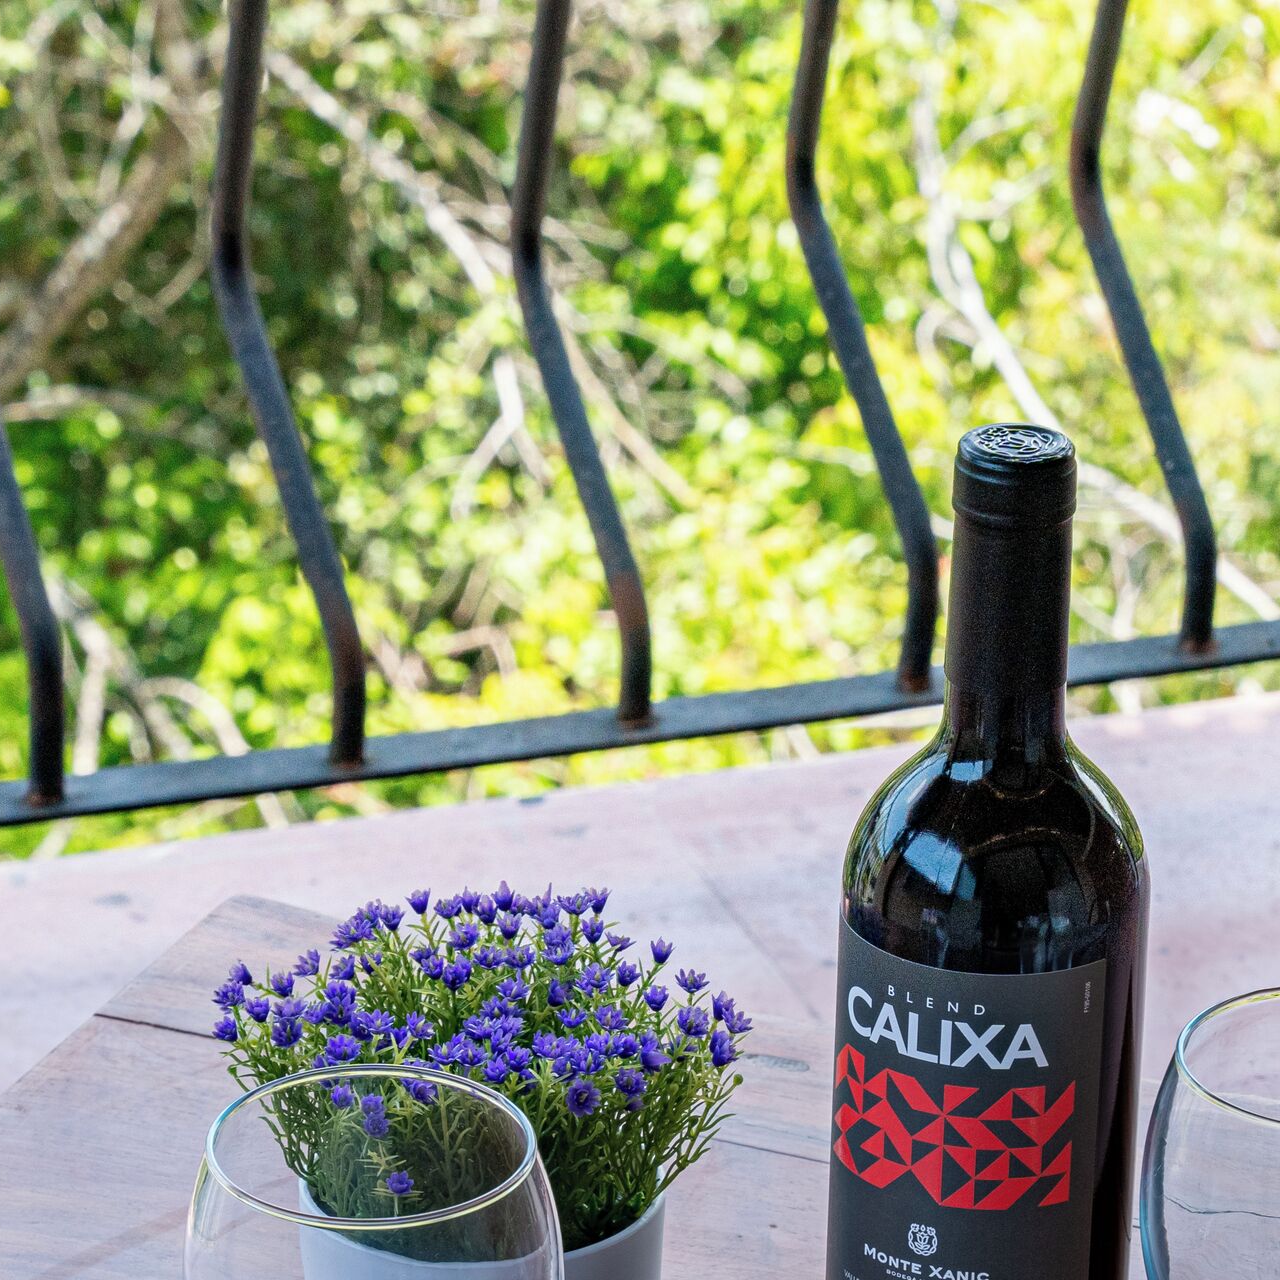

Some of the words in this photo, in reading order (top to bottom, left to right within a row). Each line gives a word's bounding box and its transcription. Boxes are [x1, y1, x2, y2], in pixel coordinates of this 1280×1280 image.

[888, 984, 985, 1016] BLEND
[848, 986, 1049, 1069] CALIXA
[864, 1243, 922, 1275] MONTE
